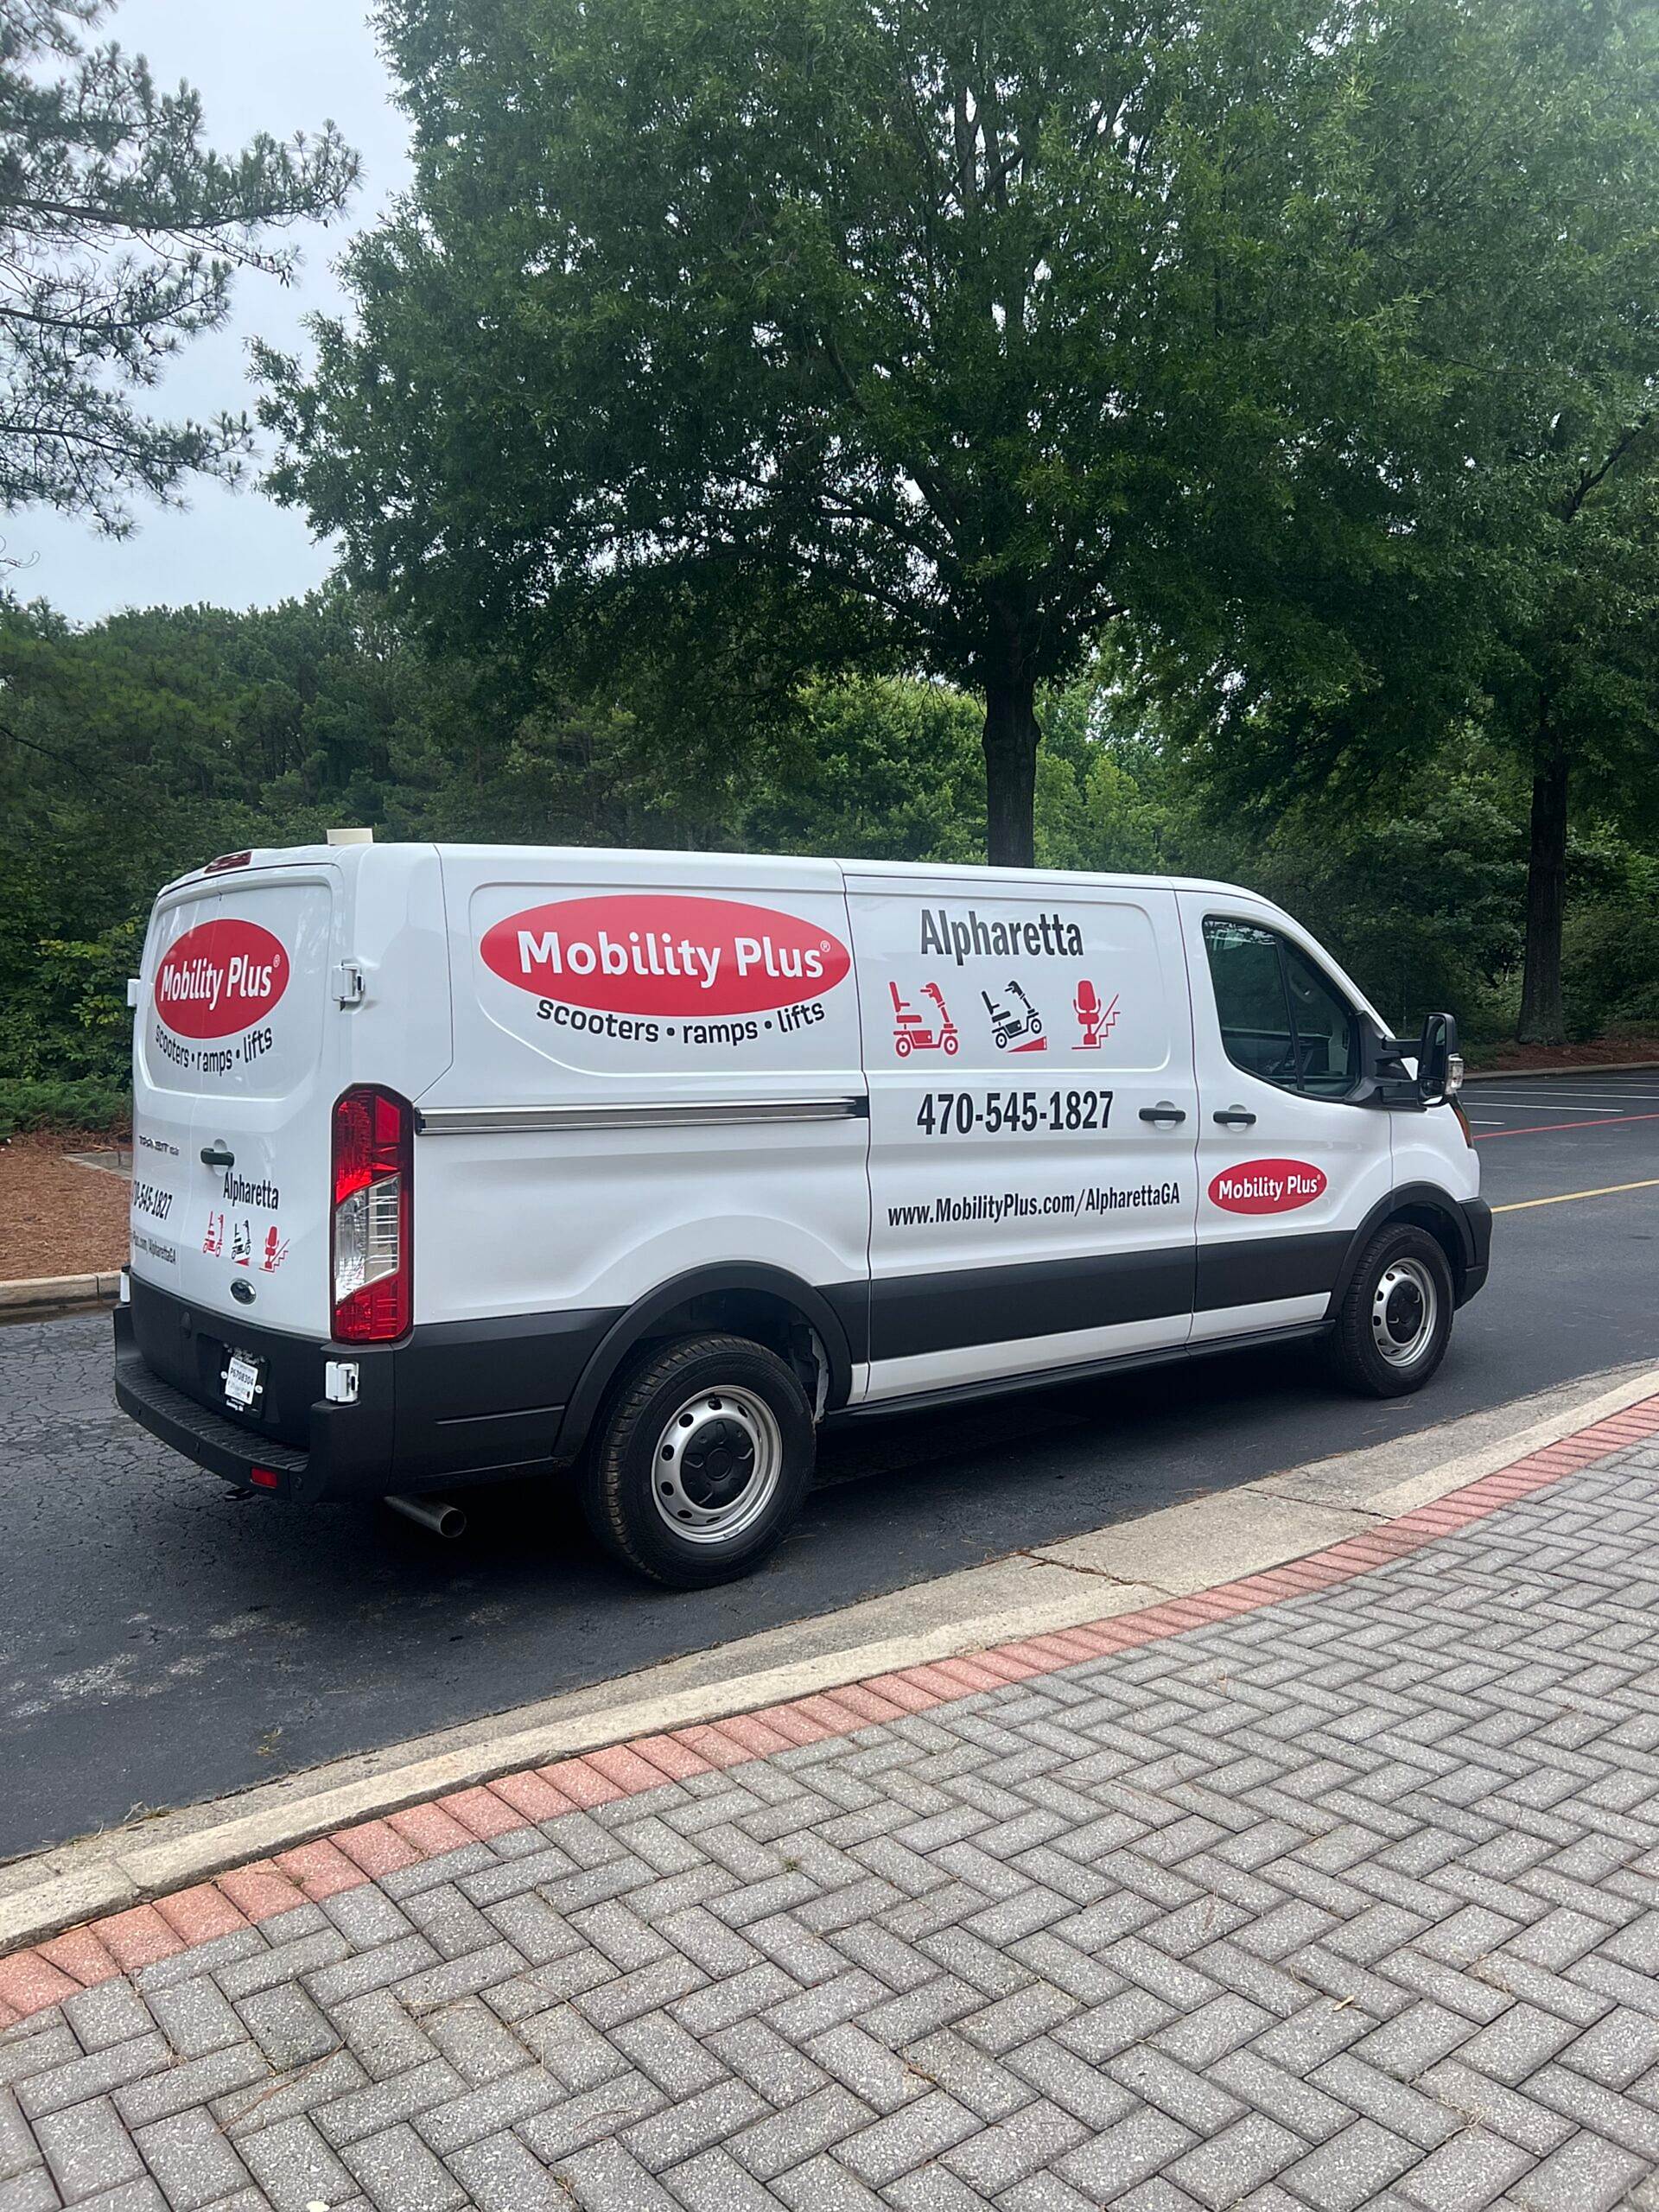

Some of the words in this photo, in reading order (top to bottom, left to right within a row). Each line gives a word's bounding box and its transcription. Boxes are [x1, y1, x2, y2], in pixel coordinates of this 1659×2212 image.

[517, 930, 721, 989] Mobility
[920, 909, 1084, 966] Alpharetta
[160, 957, 224, 1011] Mobility
[536, 999, 659, 1043] scooters
[683, 1018, 758, 1046] ramps
[777, 1001, 825, 1033] lifts
[156, 1024, 189, 1068] scooters
[196, 1049, 232, 1077] ramps
[243, 1027, 273, 1064] lifts
[917, 1090, 1114, 1135] 470-545-1827
[223, 1172, 279, 1210] Alpharetta
[887, 1182, 1179, 1226] www.MobilityPlus.com/AlpharettaGA
[1218, 1176, 1283, 1201] Mobility
